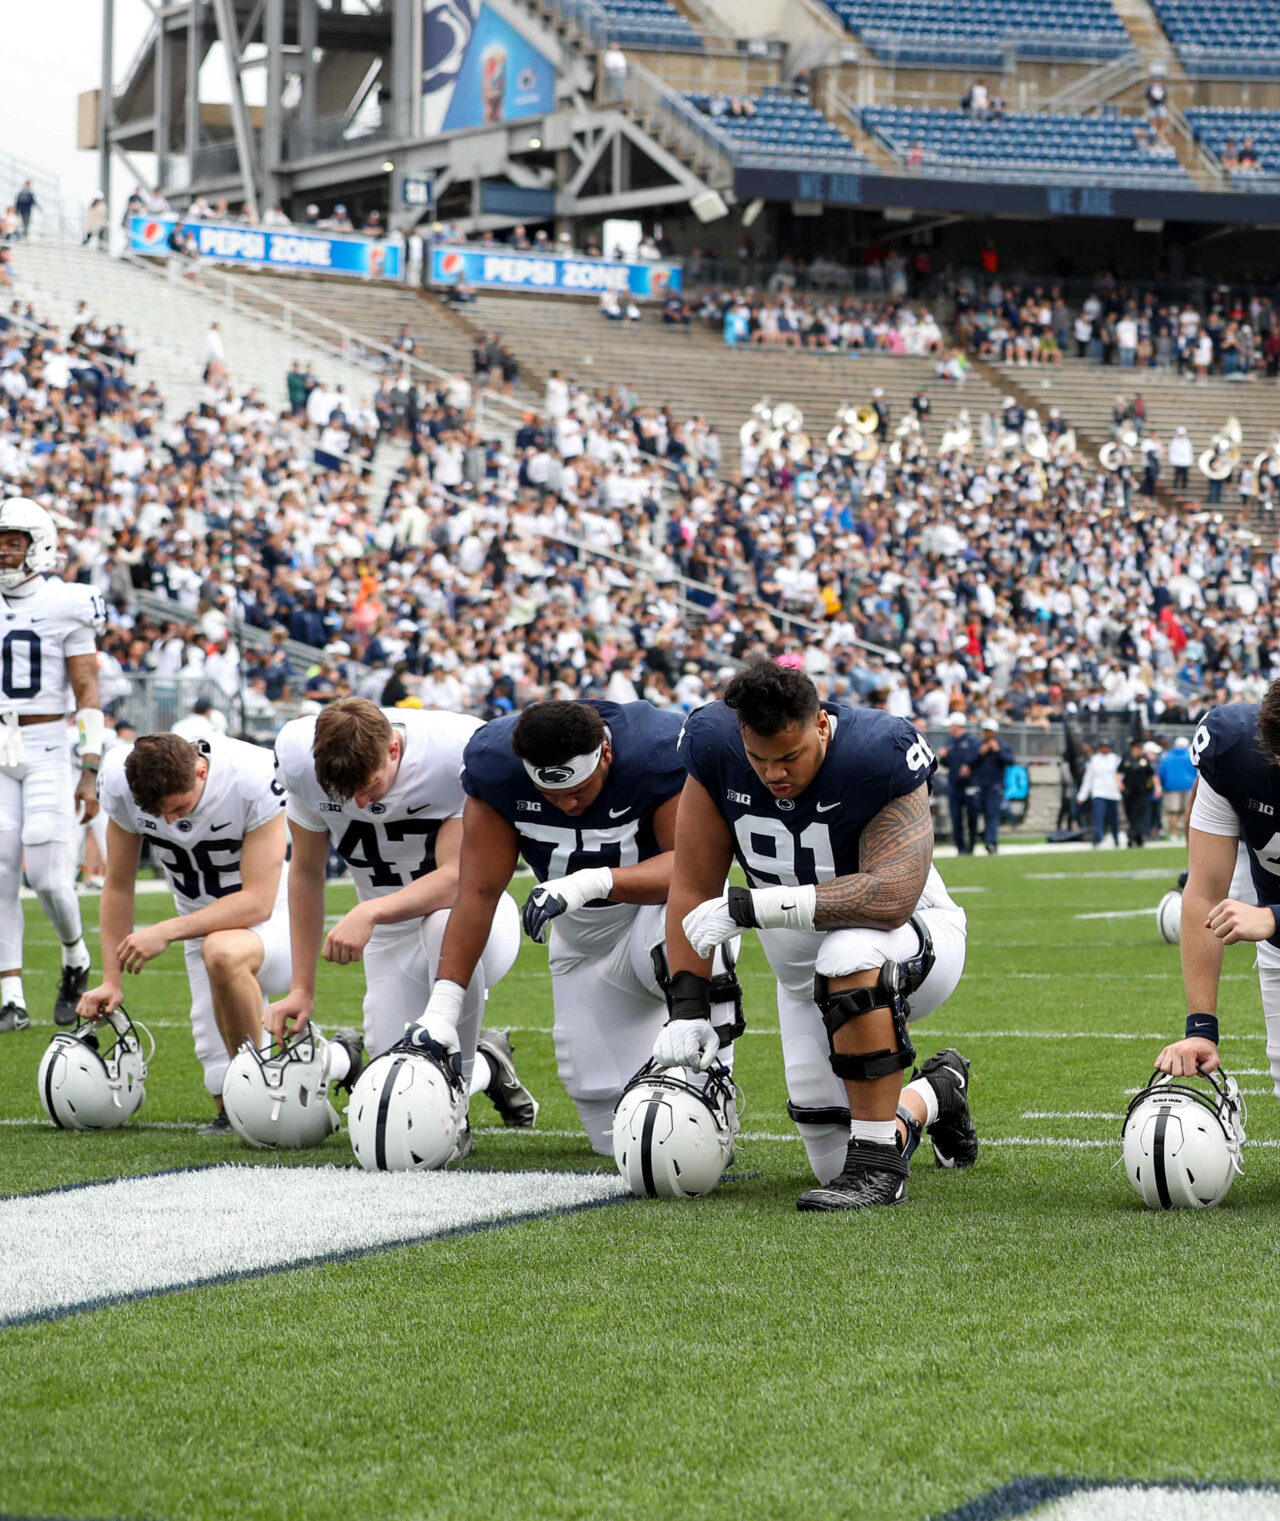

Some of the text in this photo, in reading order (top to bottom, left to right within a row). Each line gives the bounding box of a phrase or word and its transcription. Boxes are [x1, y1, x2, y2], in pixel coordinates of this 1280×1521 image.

[798, 173, 862, 203] WE ARE
[1047, 186, 1115, 216] WE ARE
[200, 228, 331, 267] PEPSI ZONE
[483, 256, 630, 291] PEPSI ZONE
[336, 818, 443, 887] 47
[514, 818, 639, 882] 77
[734, 813, 838, 889] 91
